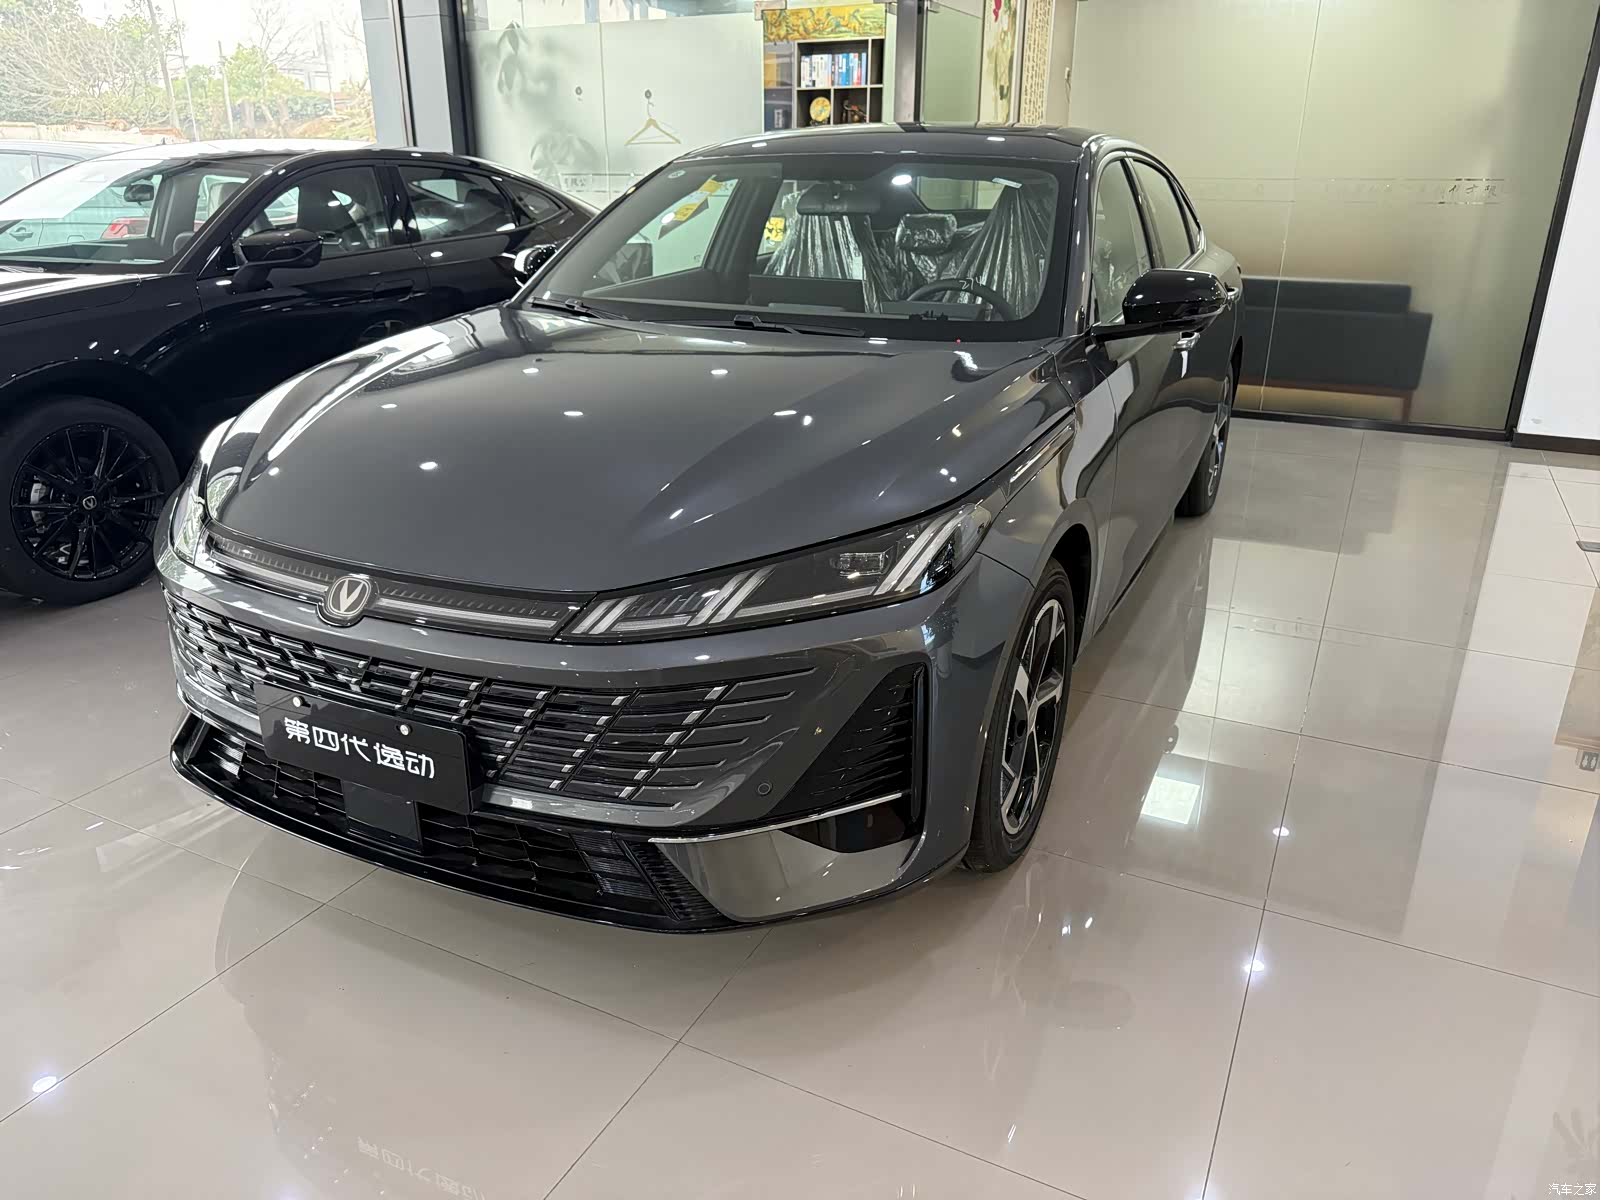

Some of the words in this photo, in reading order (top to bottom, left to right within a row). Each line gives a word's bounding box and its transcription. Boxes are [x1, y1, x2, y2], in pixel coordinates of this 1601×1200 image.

[284, 717, 435, 779] 第四代逸动
